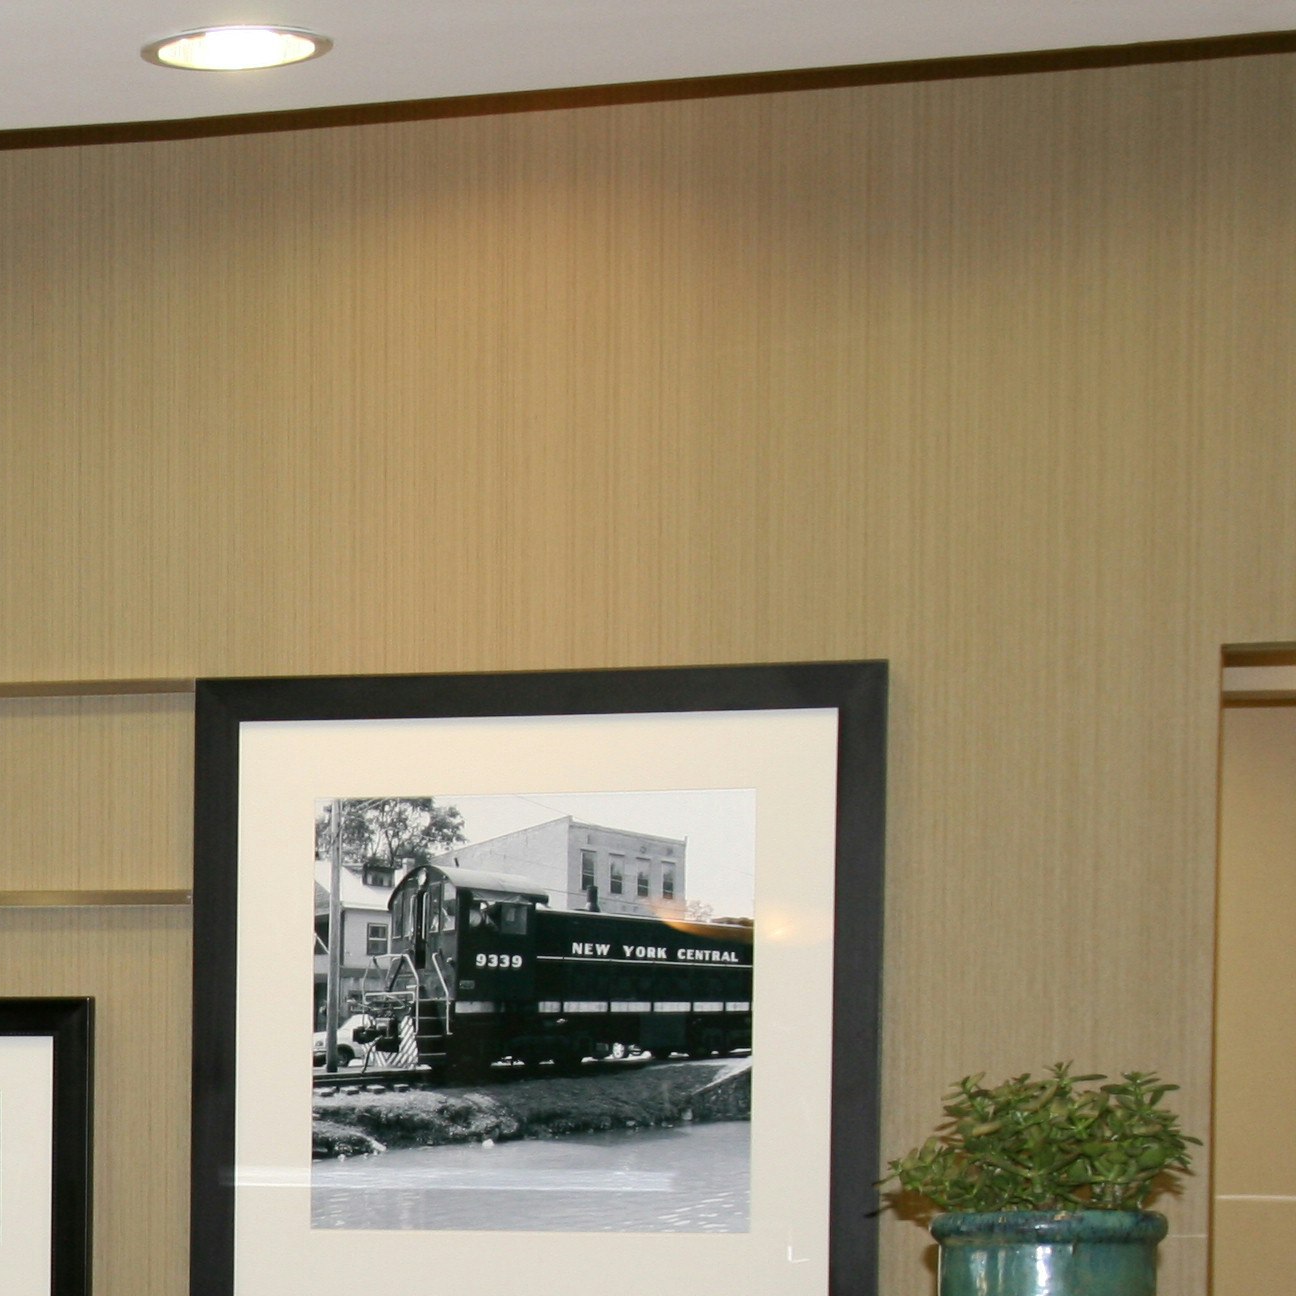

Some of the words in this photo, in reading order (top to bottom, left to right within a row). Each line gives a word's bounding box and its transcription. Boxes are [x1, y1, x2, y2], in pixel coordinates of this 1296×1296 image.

[475, 953, 524, 969] 9339
[571, 941, 611, 956] NEW
[623, 945, 667, 960] YORK
[677, 948, 739, 963] CENTRAL
